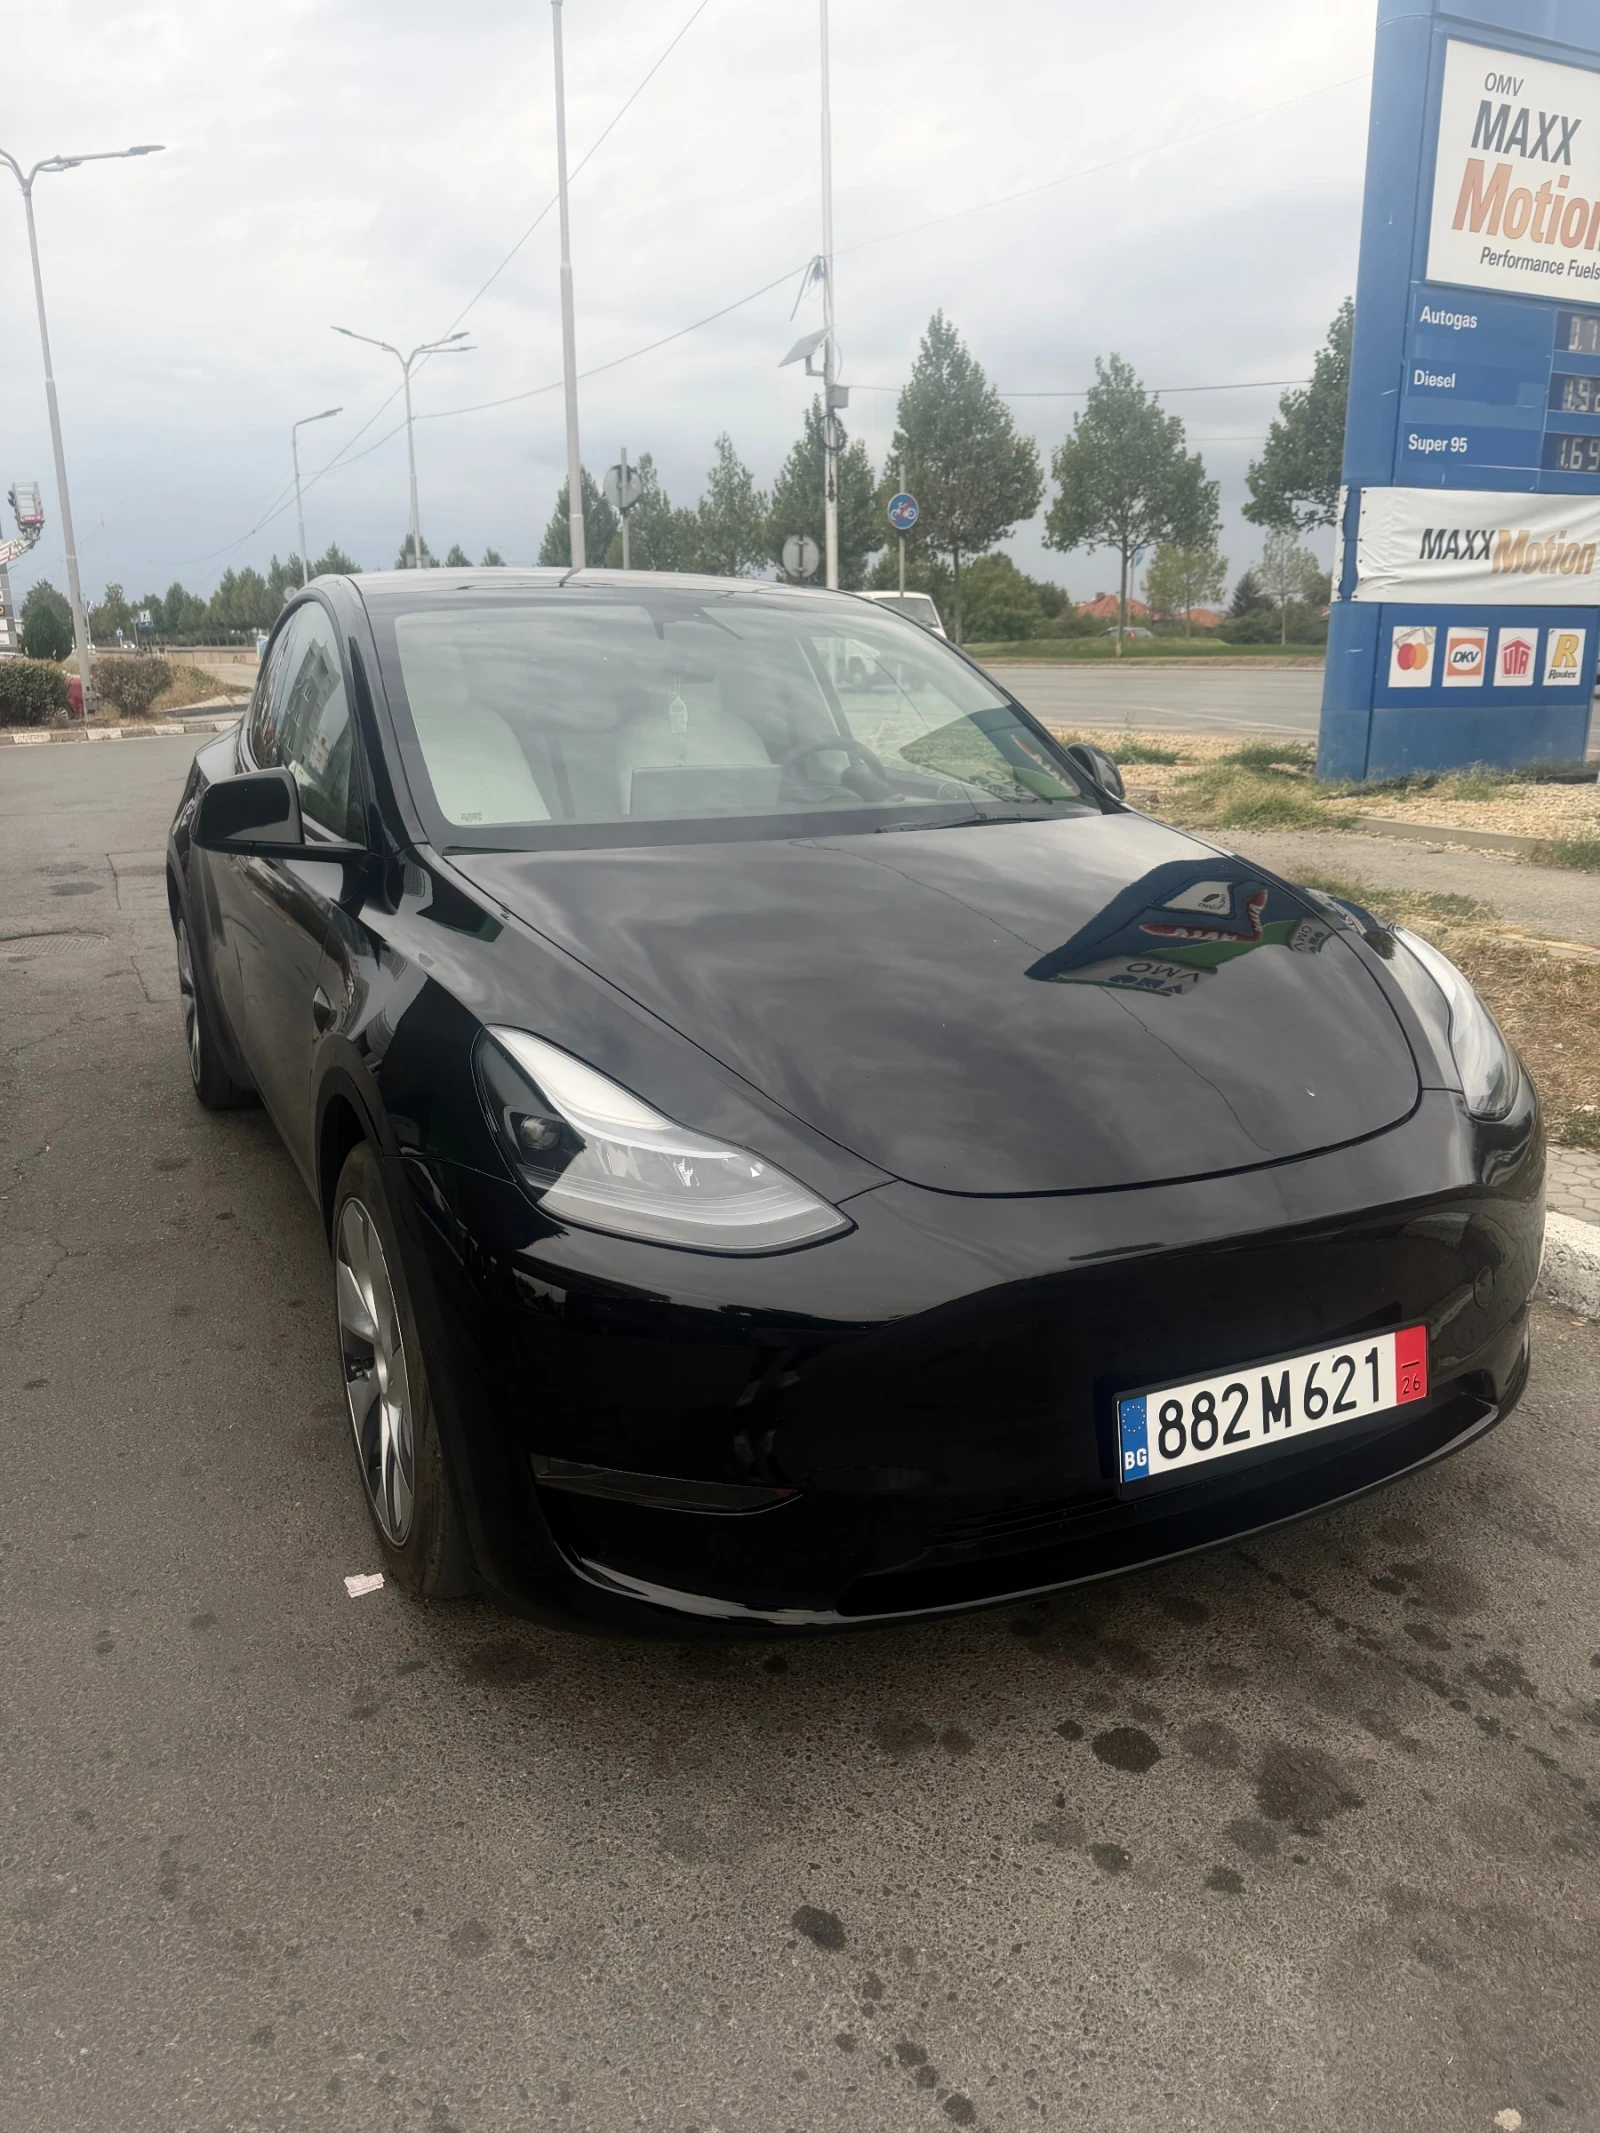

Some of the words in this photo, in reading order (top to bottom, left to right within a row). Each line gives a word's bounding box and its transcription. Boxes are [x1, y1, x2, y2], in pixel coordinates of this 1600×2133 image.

[1484, 72, 1525, 96] OMV
[1470, 99, 1582, 166] MAXX
[1479, 246, 1564, 275] Performance
[1567, 259, 1600, 281] Fuels
[1419, 306, 1478, 330] Autogas
[1413, 369, 1456, 388] Diesel
[1408, 433, 1448, 454] Super
[1450, 437, 1468, 453] 95
[1452, 651, 1480, 663] DKV
[1503, 640, 1532, 675] UTA
[1401, 1372, 1421, 1395] 26
[1124, 1447, 1148, 1471] BG
